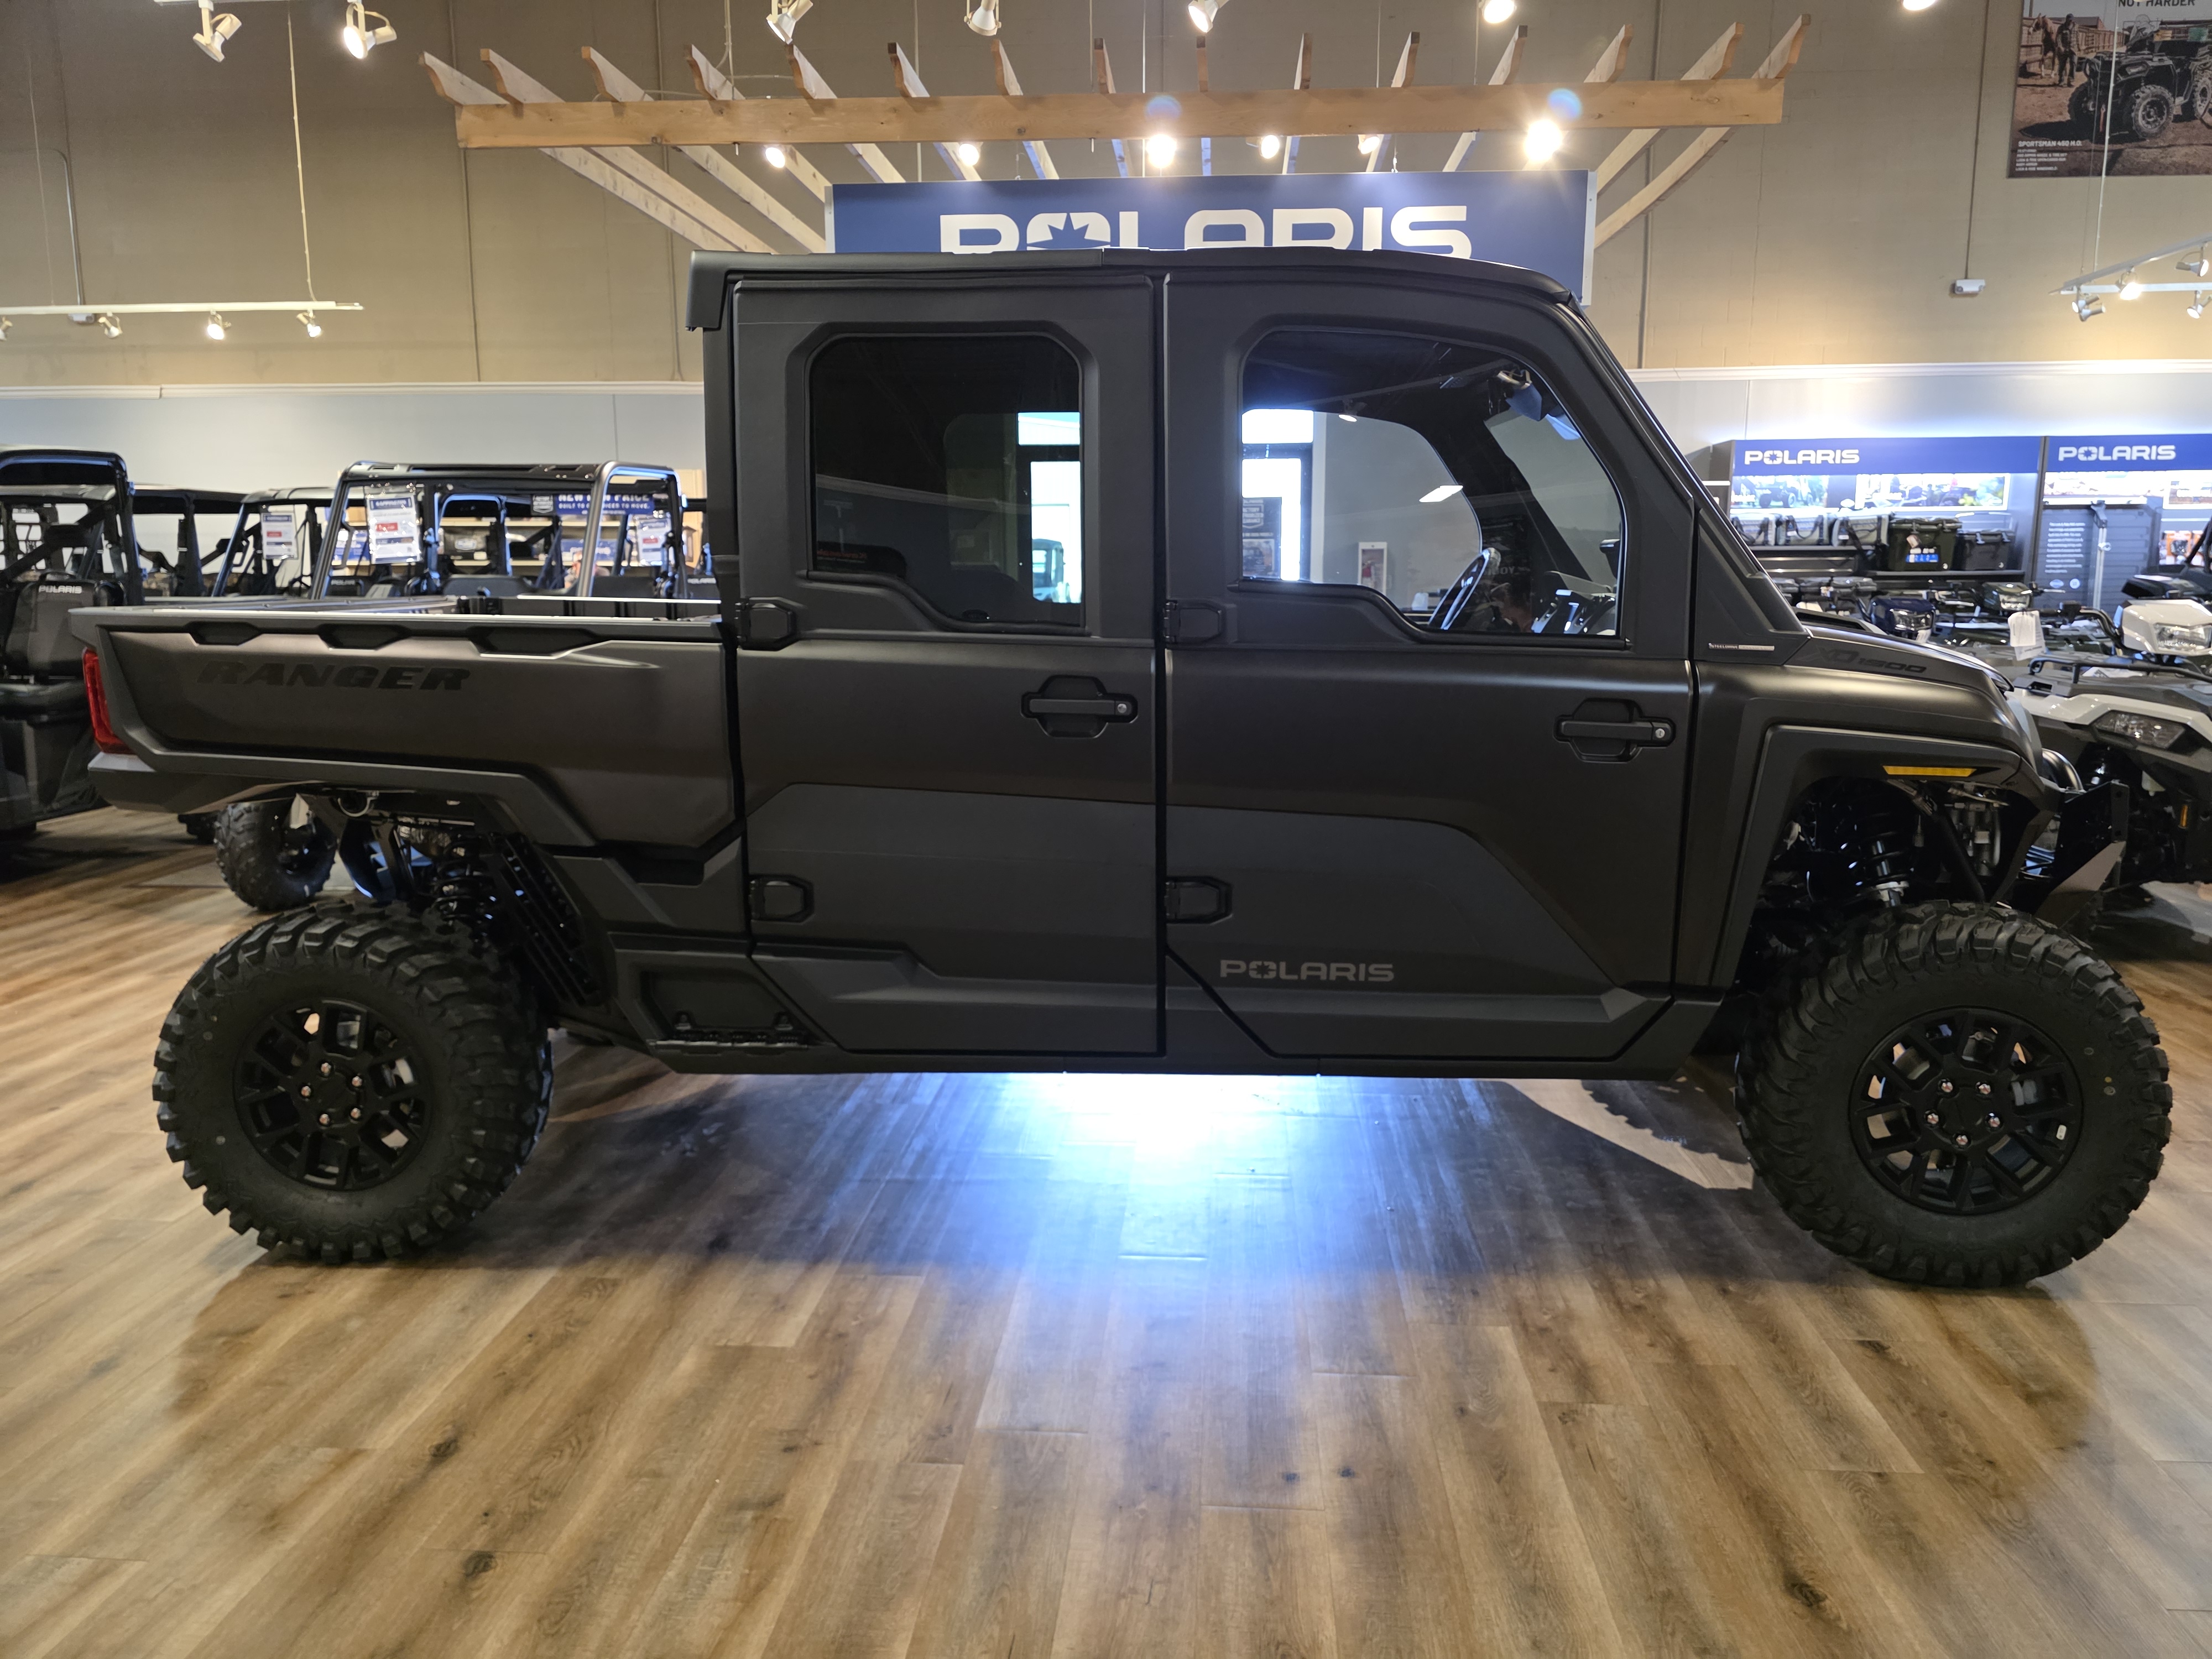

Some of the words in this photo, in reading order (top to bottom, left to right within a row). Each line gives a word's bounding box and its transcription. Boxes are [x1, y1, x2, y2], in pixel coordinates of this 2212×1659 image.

[1744, 449, 1860, 465] POLARIS
[2058, 445, 2176, 461] POLARIS
[38, 585, 82, 594] POLARIS
[197, 661, 471, 691] RANGER
[1219, 959, 1395, 982] POLARIS
